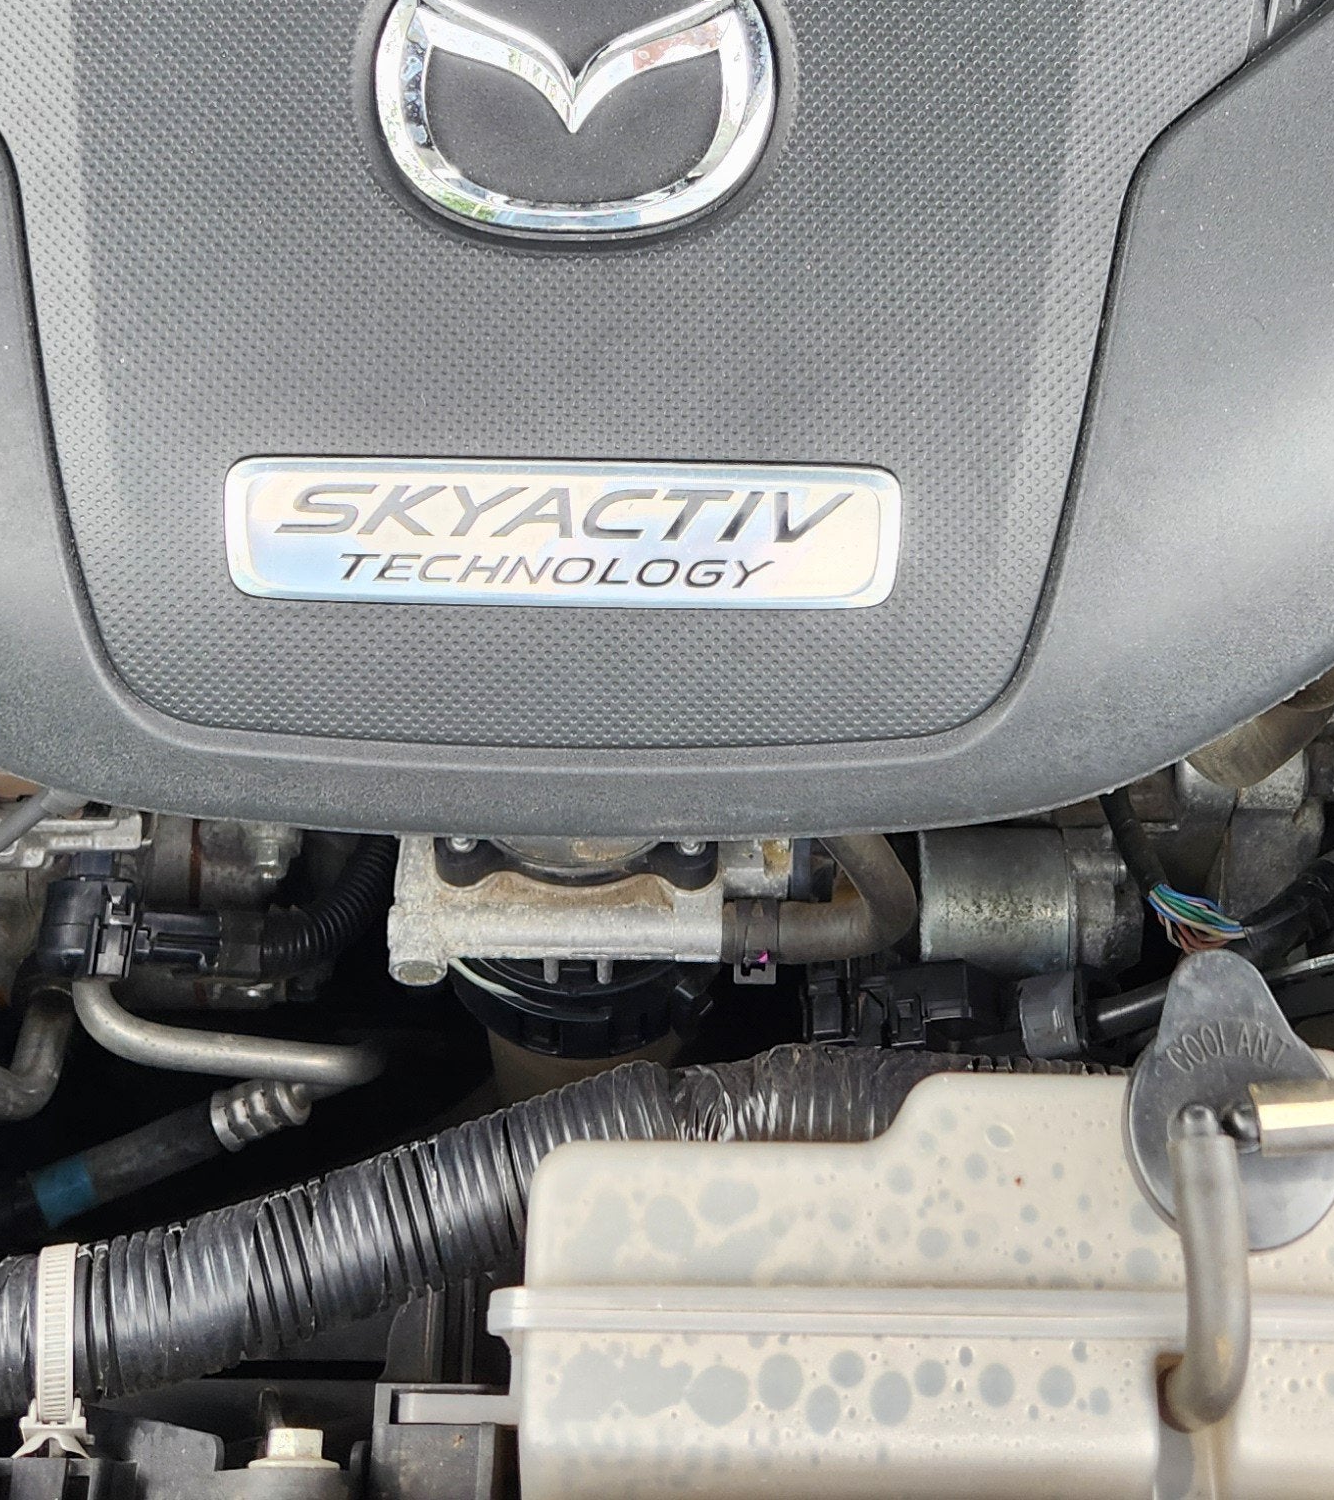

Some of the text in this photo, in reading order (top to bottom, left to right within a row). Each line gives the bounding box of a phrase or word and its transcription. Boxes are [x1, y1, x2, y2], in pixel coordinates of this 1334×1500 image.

[274, 483, 854, 544] SKYACTIV
[339, 552, 777, 590] TECHNOLOGY
[1166, 1020, 1293, 1074] COOLANT
